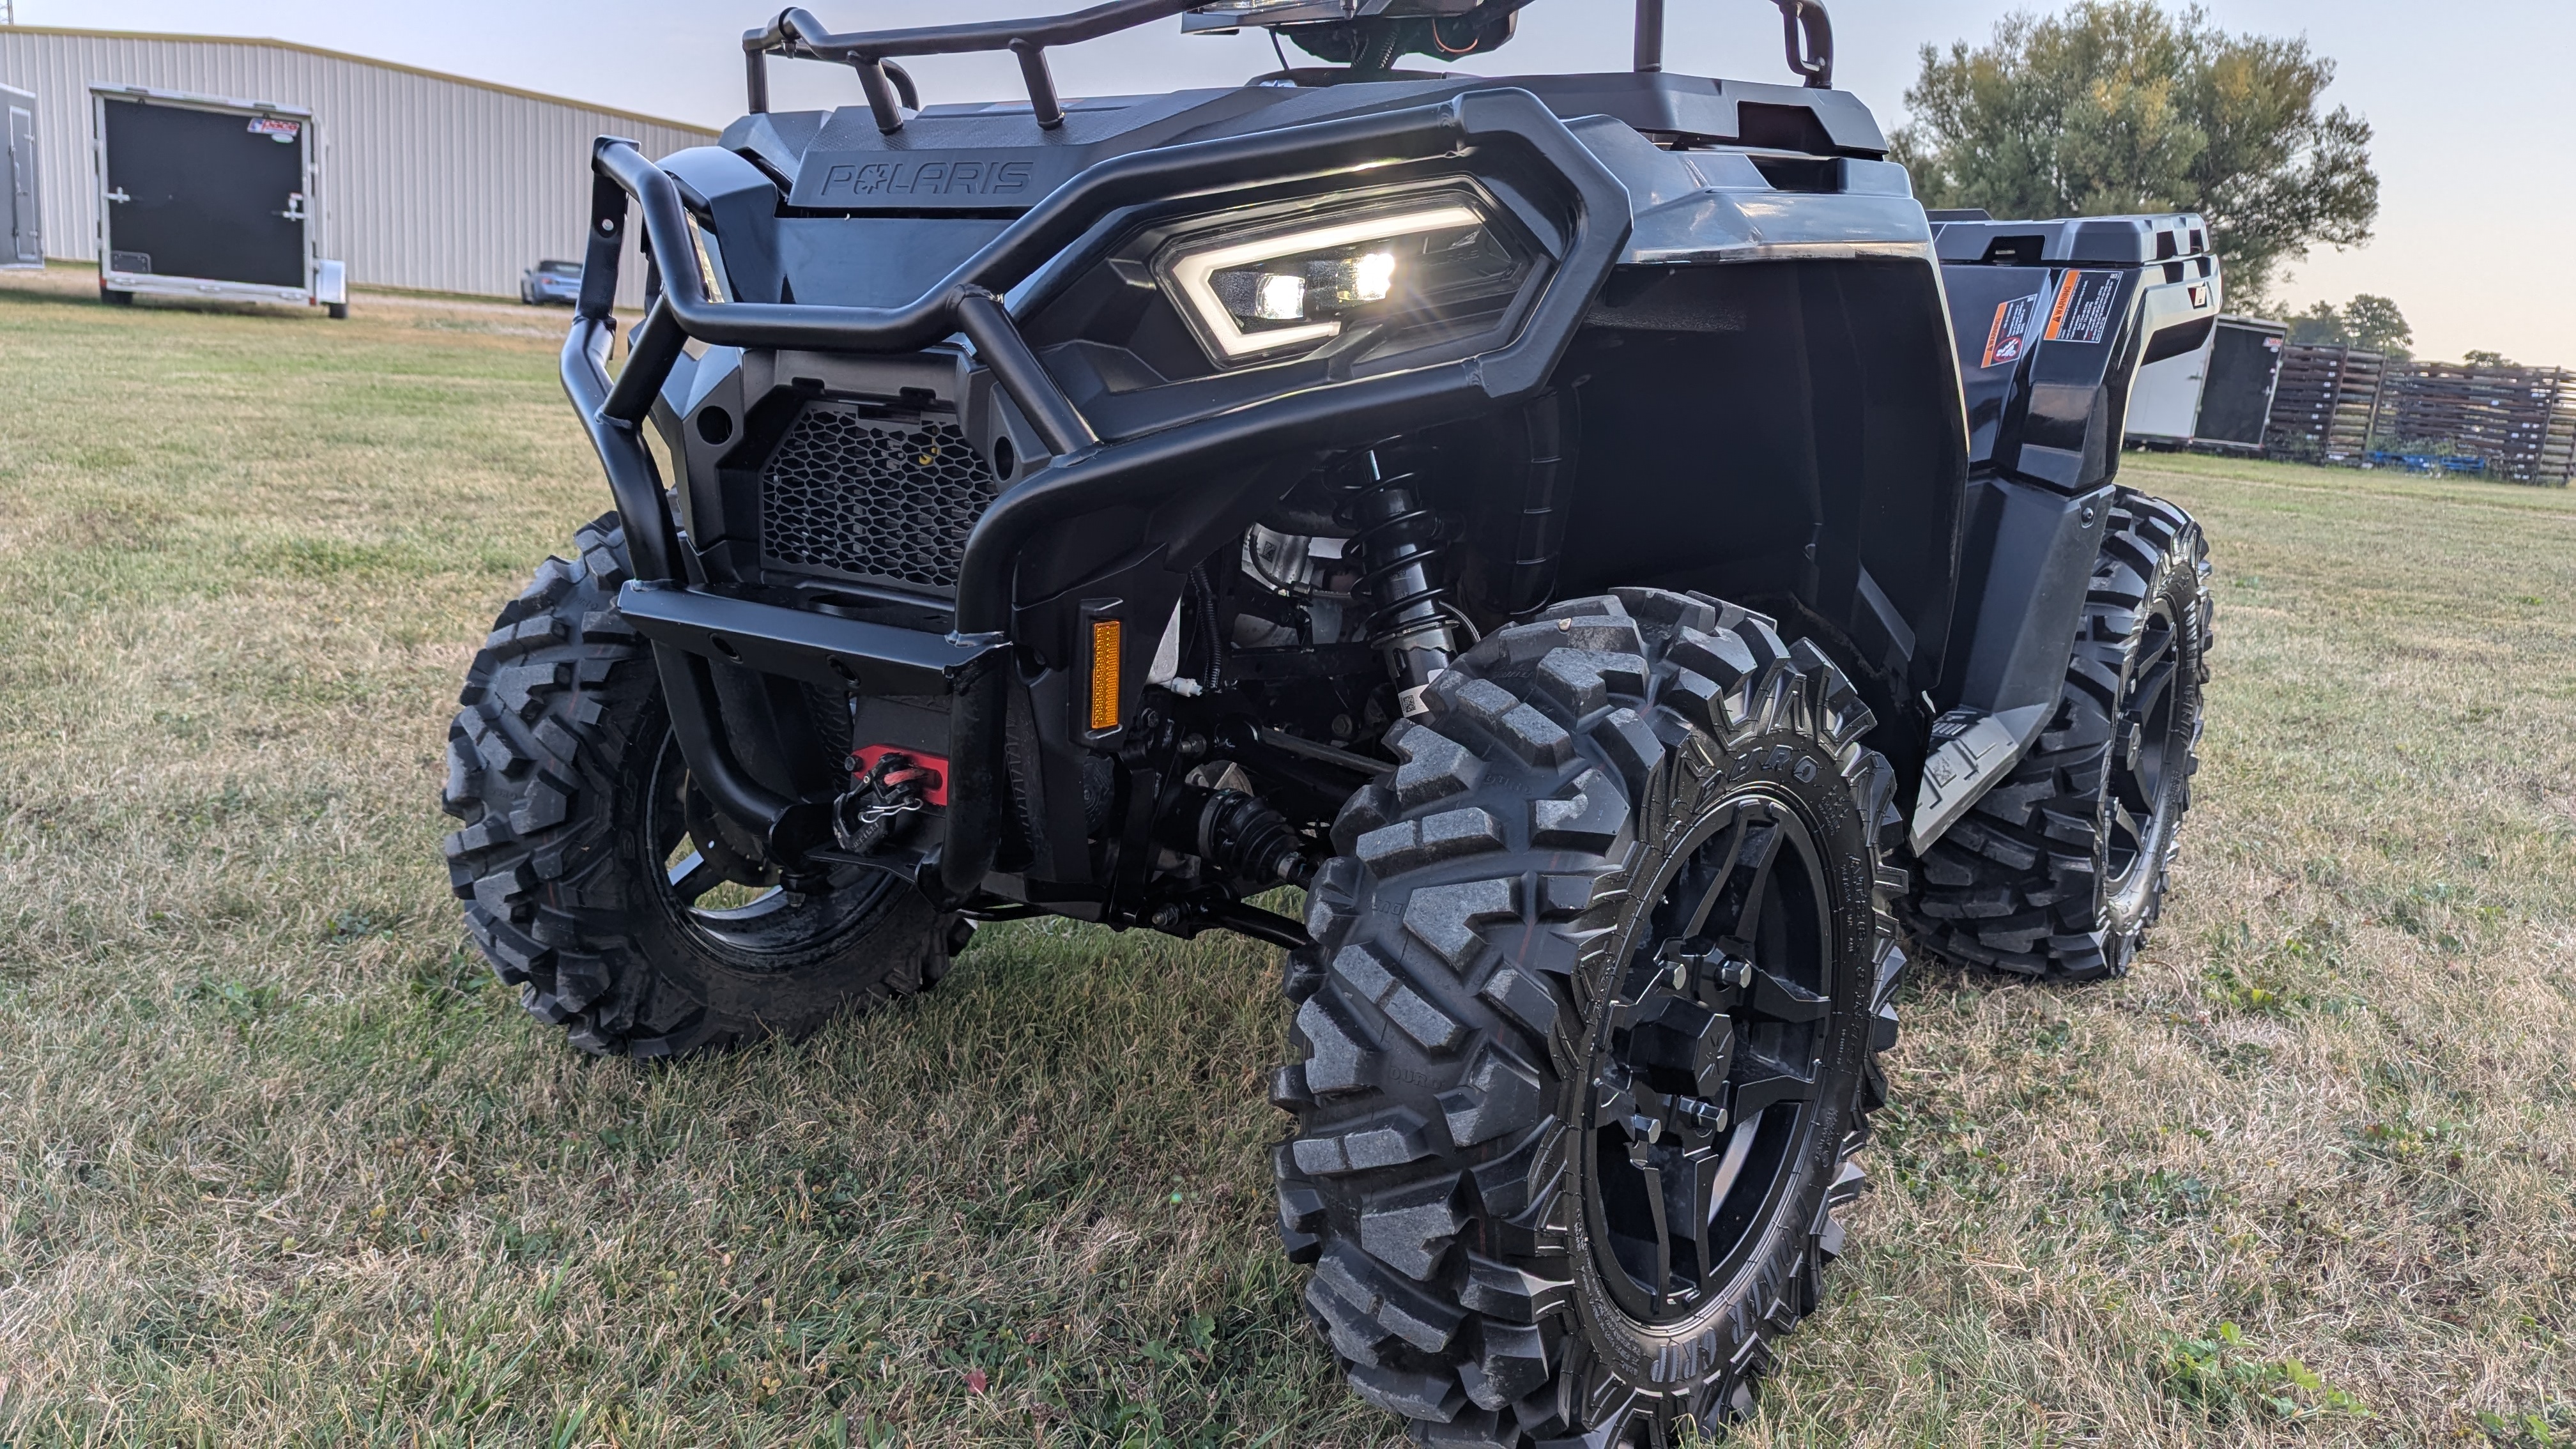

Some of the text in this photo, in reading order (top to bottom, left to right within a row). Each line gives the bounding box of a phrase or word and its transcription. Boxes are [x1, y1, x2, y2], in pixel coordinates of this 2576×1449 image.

[821, 161, 1035, 196] POLARIS
[2056, 285, 2071, 316] WARNING
[1692, 744, 1820, 815] DURO
[1389, 1065, 1443, 1090] DURO
[1650, 1326, 1717, 1383] GRIP
